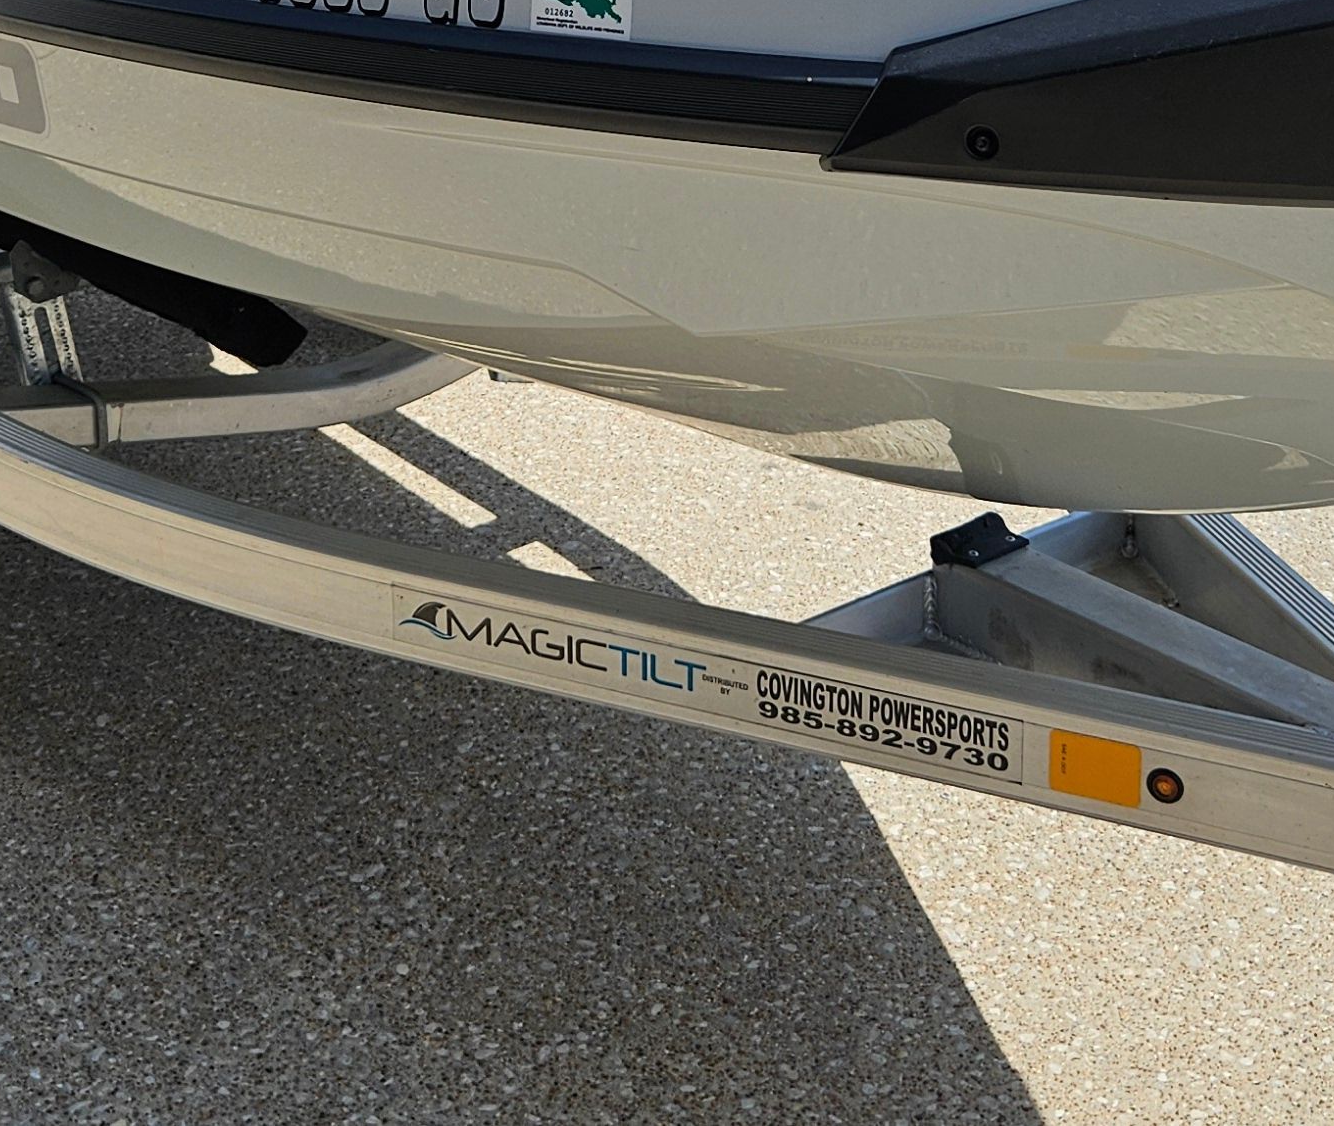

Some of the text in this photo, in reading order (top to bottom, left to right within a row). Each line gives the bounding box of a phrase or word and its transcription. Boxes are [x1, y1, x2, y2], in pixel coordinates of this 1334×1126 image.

[702, 674, 749, 691] DISTRIBUTED
[720, 687, 731, 697] BY
[757, 670, 1009, 752] COVINGTON POWERSPORTS
[758, 700, 1009, 771] 985-892-9730
